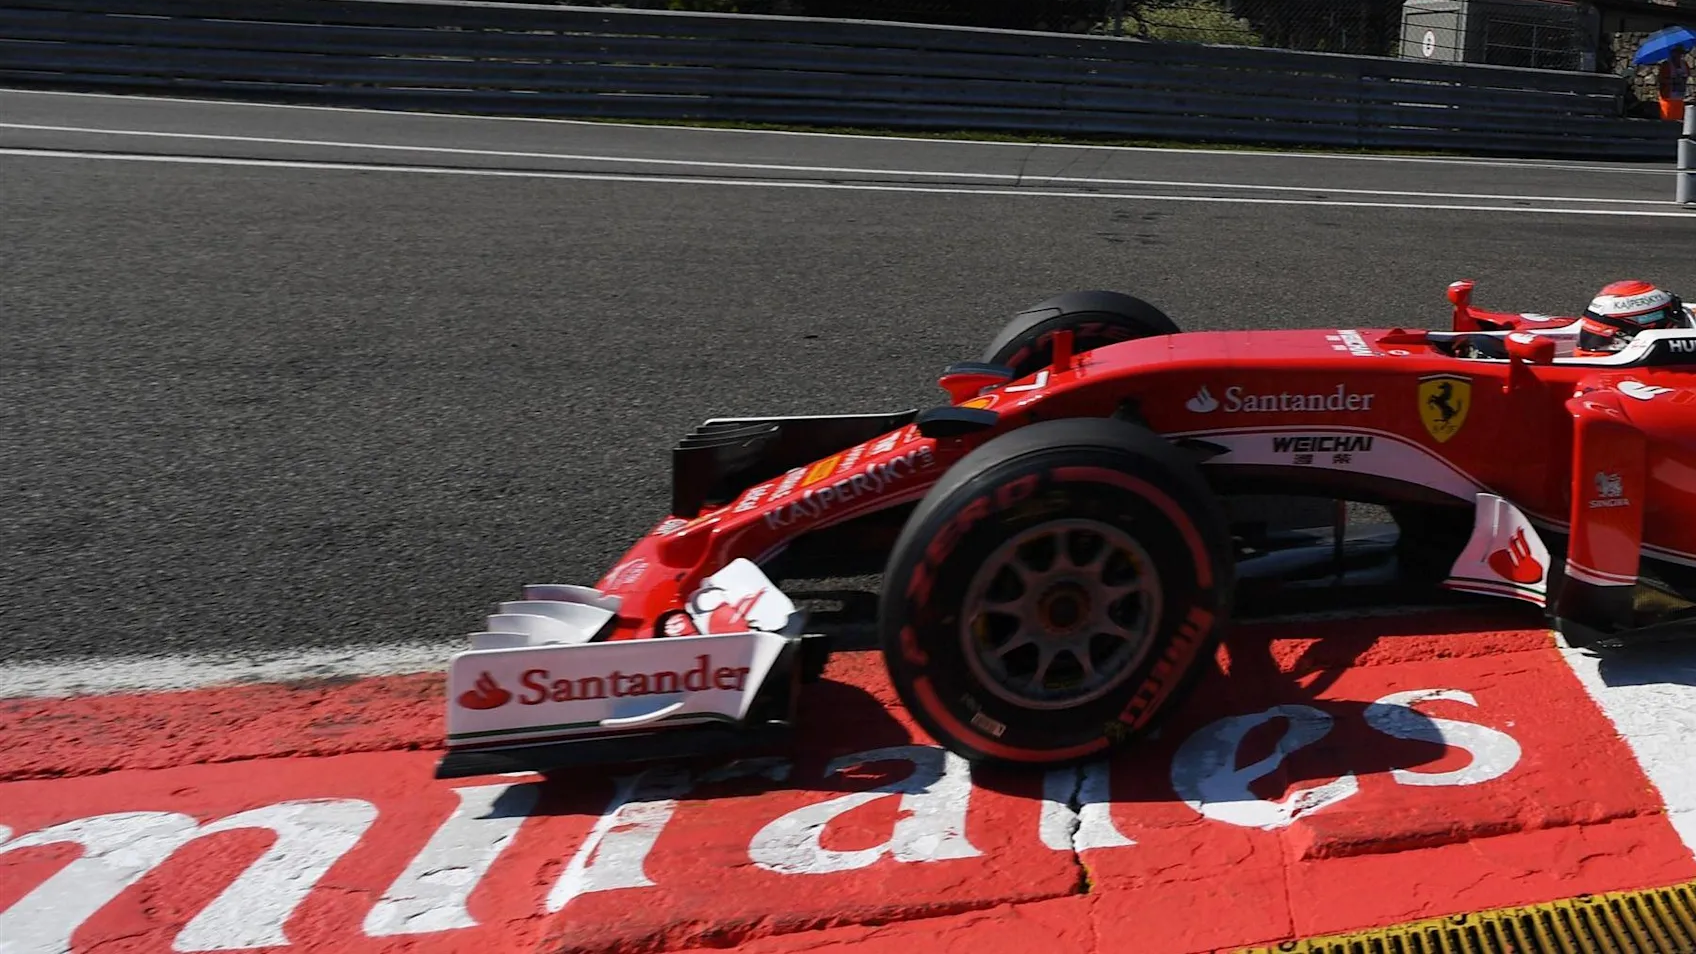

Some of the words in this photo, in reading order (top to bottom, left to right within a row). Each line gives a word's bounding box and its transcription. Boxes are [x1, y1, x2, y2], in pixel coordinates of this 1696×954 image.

[1224, 384, 1375, 413] Santander
[1272, 436, 1374, 453] WEICHAI
[763, 454, 919, 530] KASPERSKY
[517, 654, 750, 706] Santander
